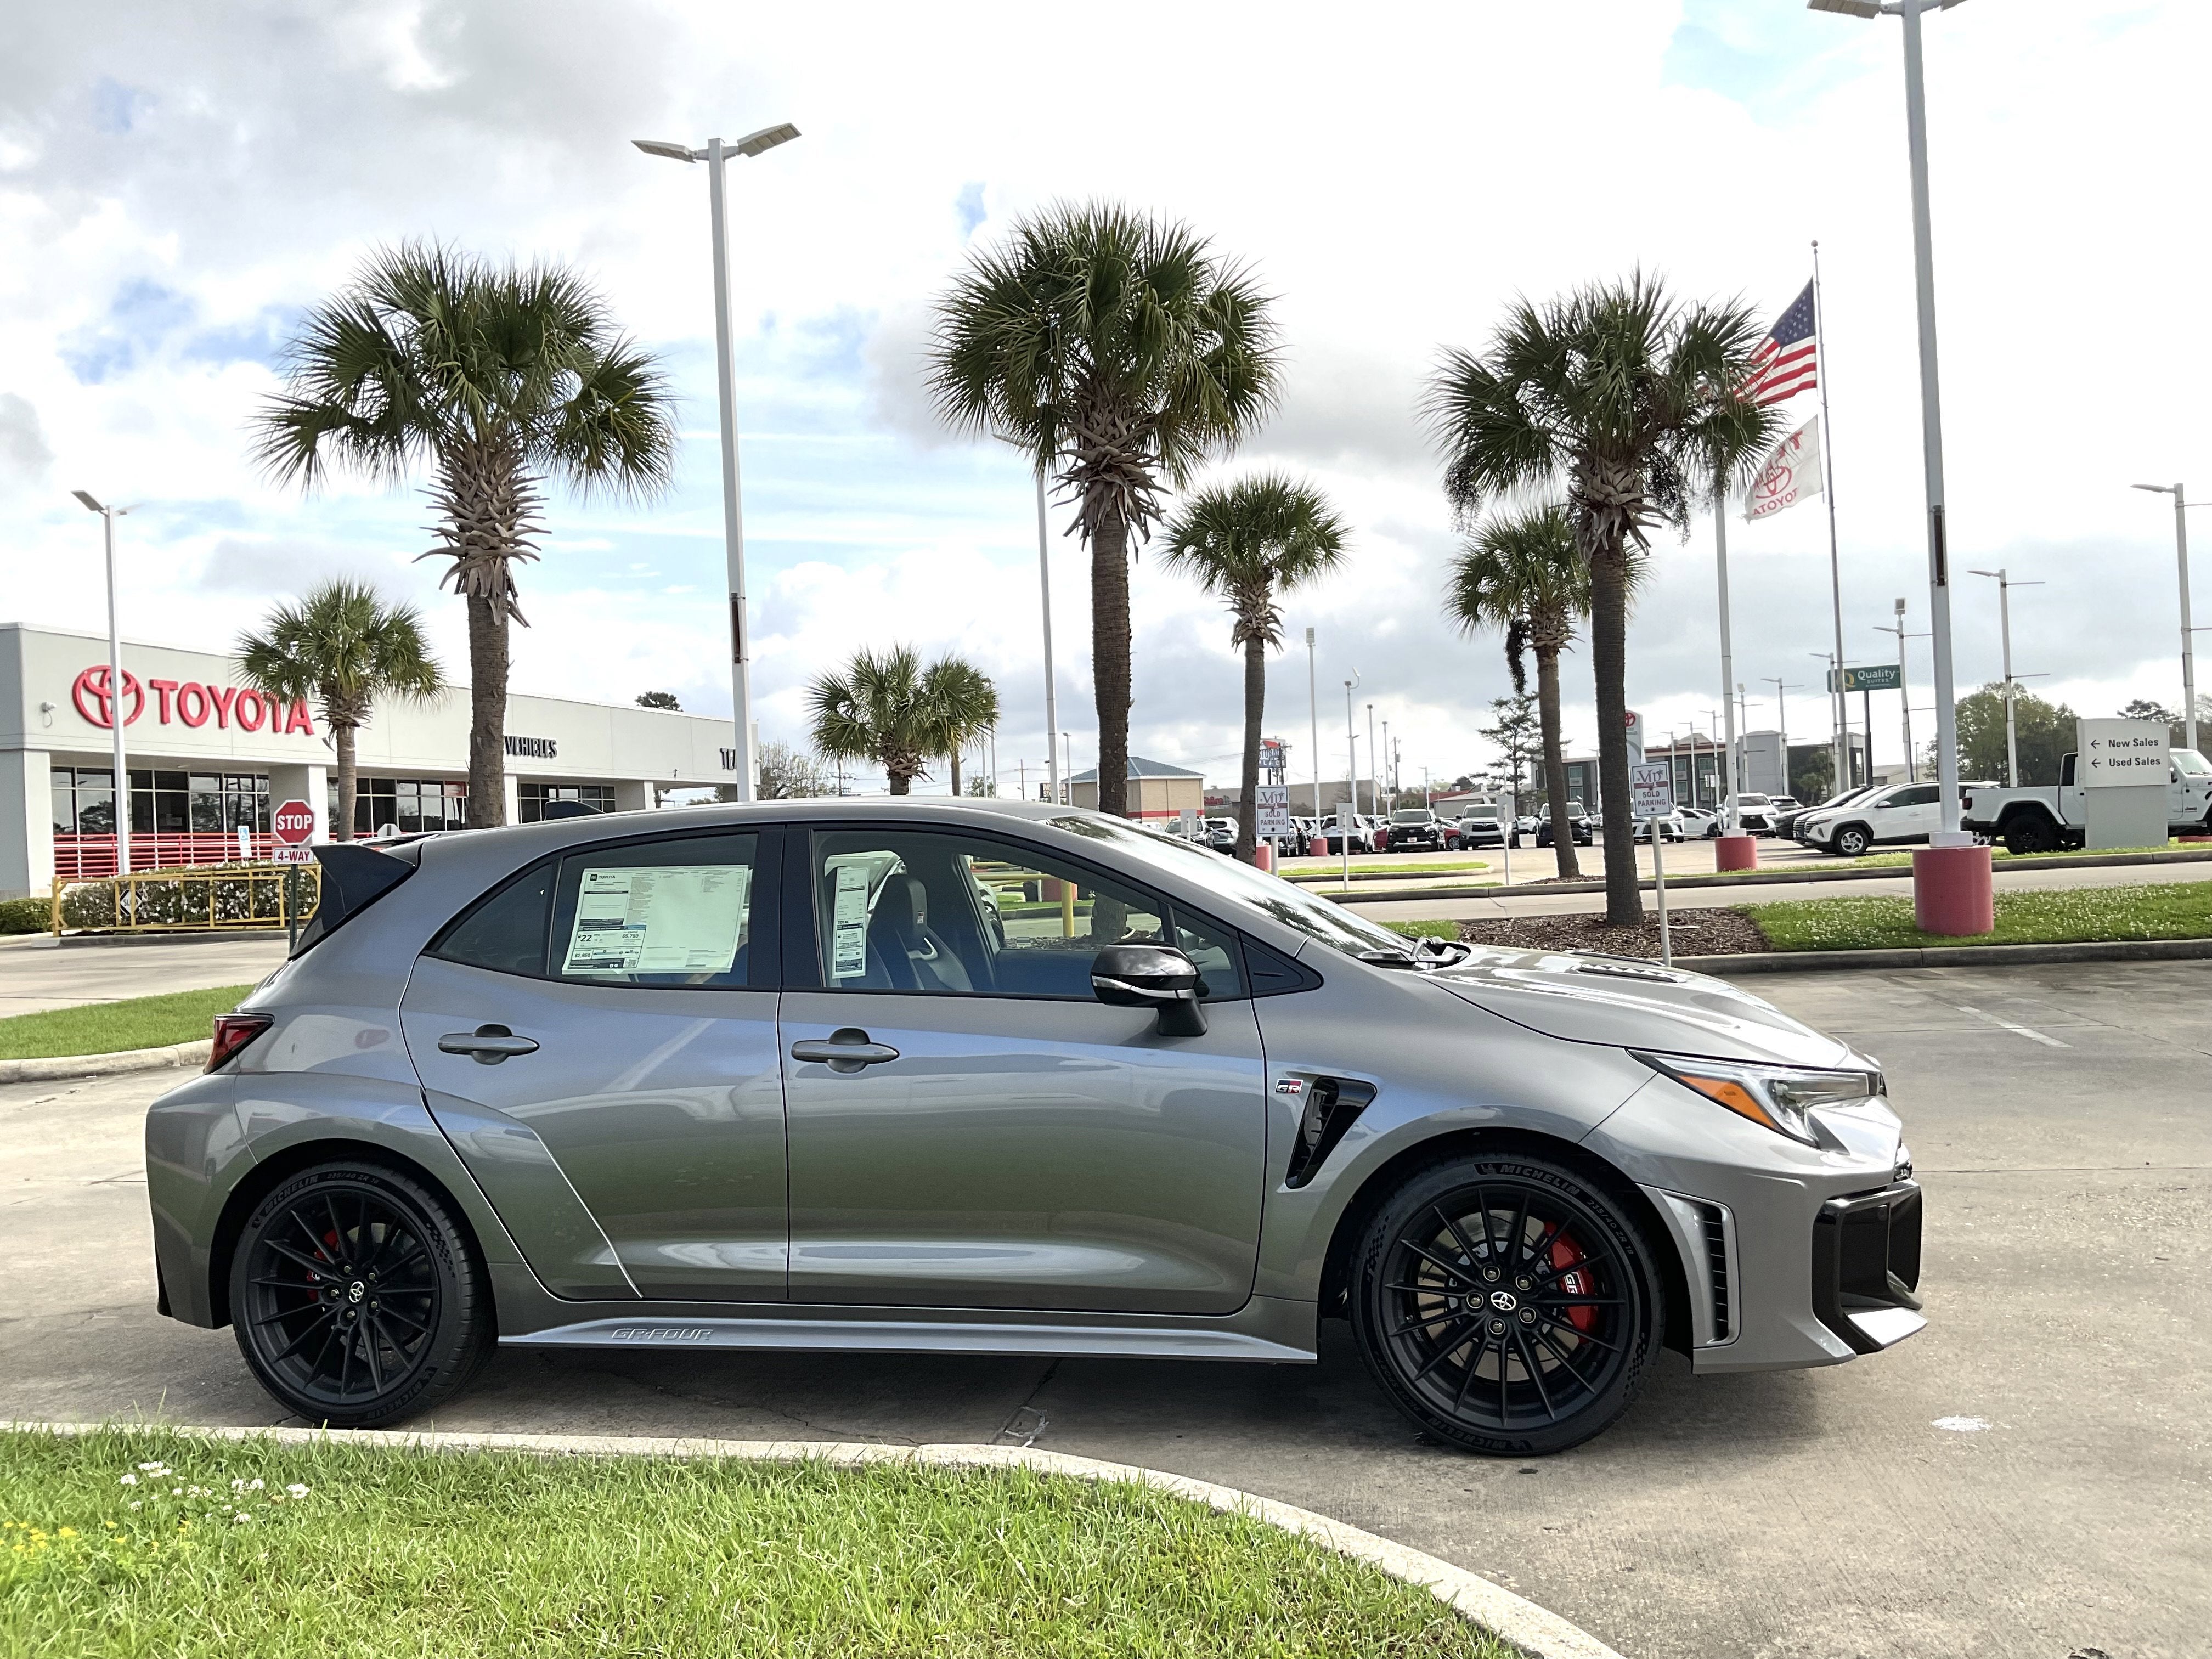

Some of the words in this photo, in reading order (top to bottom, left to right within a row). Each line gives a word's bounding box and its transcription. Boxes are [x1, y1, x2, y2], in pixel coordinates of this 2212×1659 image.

[1858, 669, 1895, 681] Quality
[150, 679, 315, 735] TOYOTA
[504, 735, 558, 758] VEHICLES
[2108, 739, 2130, 748] New
[2132, 738, 2159, 747] Sales
[2109, 758, 2132, 767] Used
[2135, 757, 2160, 766] Sales
[1638, 799, 1666, 807] PARKING
[277, 814, 313, 830] STOP
[278, 851, 311, 861] 4-WAY
[1276, 1085, 1300, 1093] GR
[1500, 1165, 1581, 1195] MICHELIN
[264, 1175, 319, 1214] MICHELIN
[1427, 1417, 1511, 1449] MICHELIN
